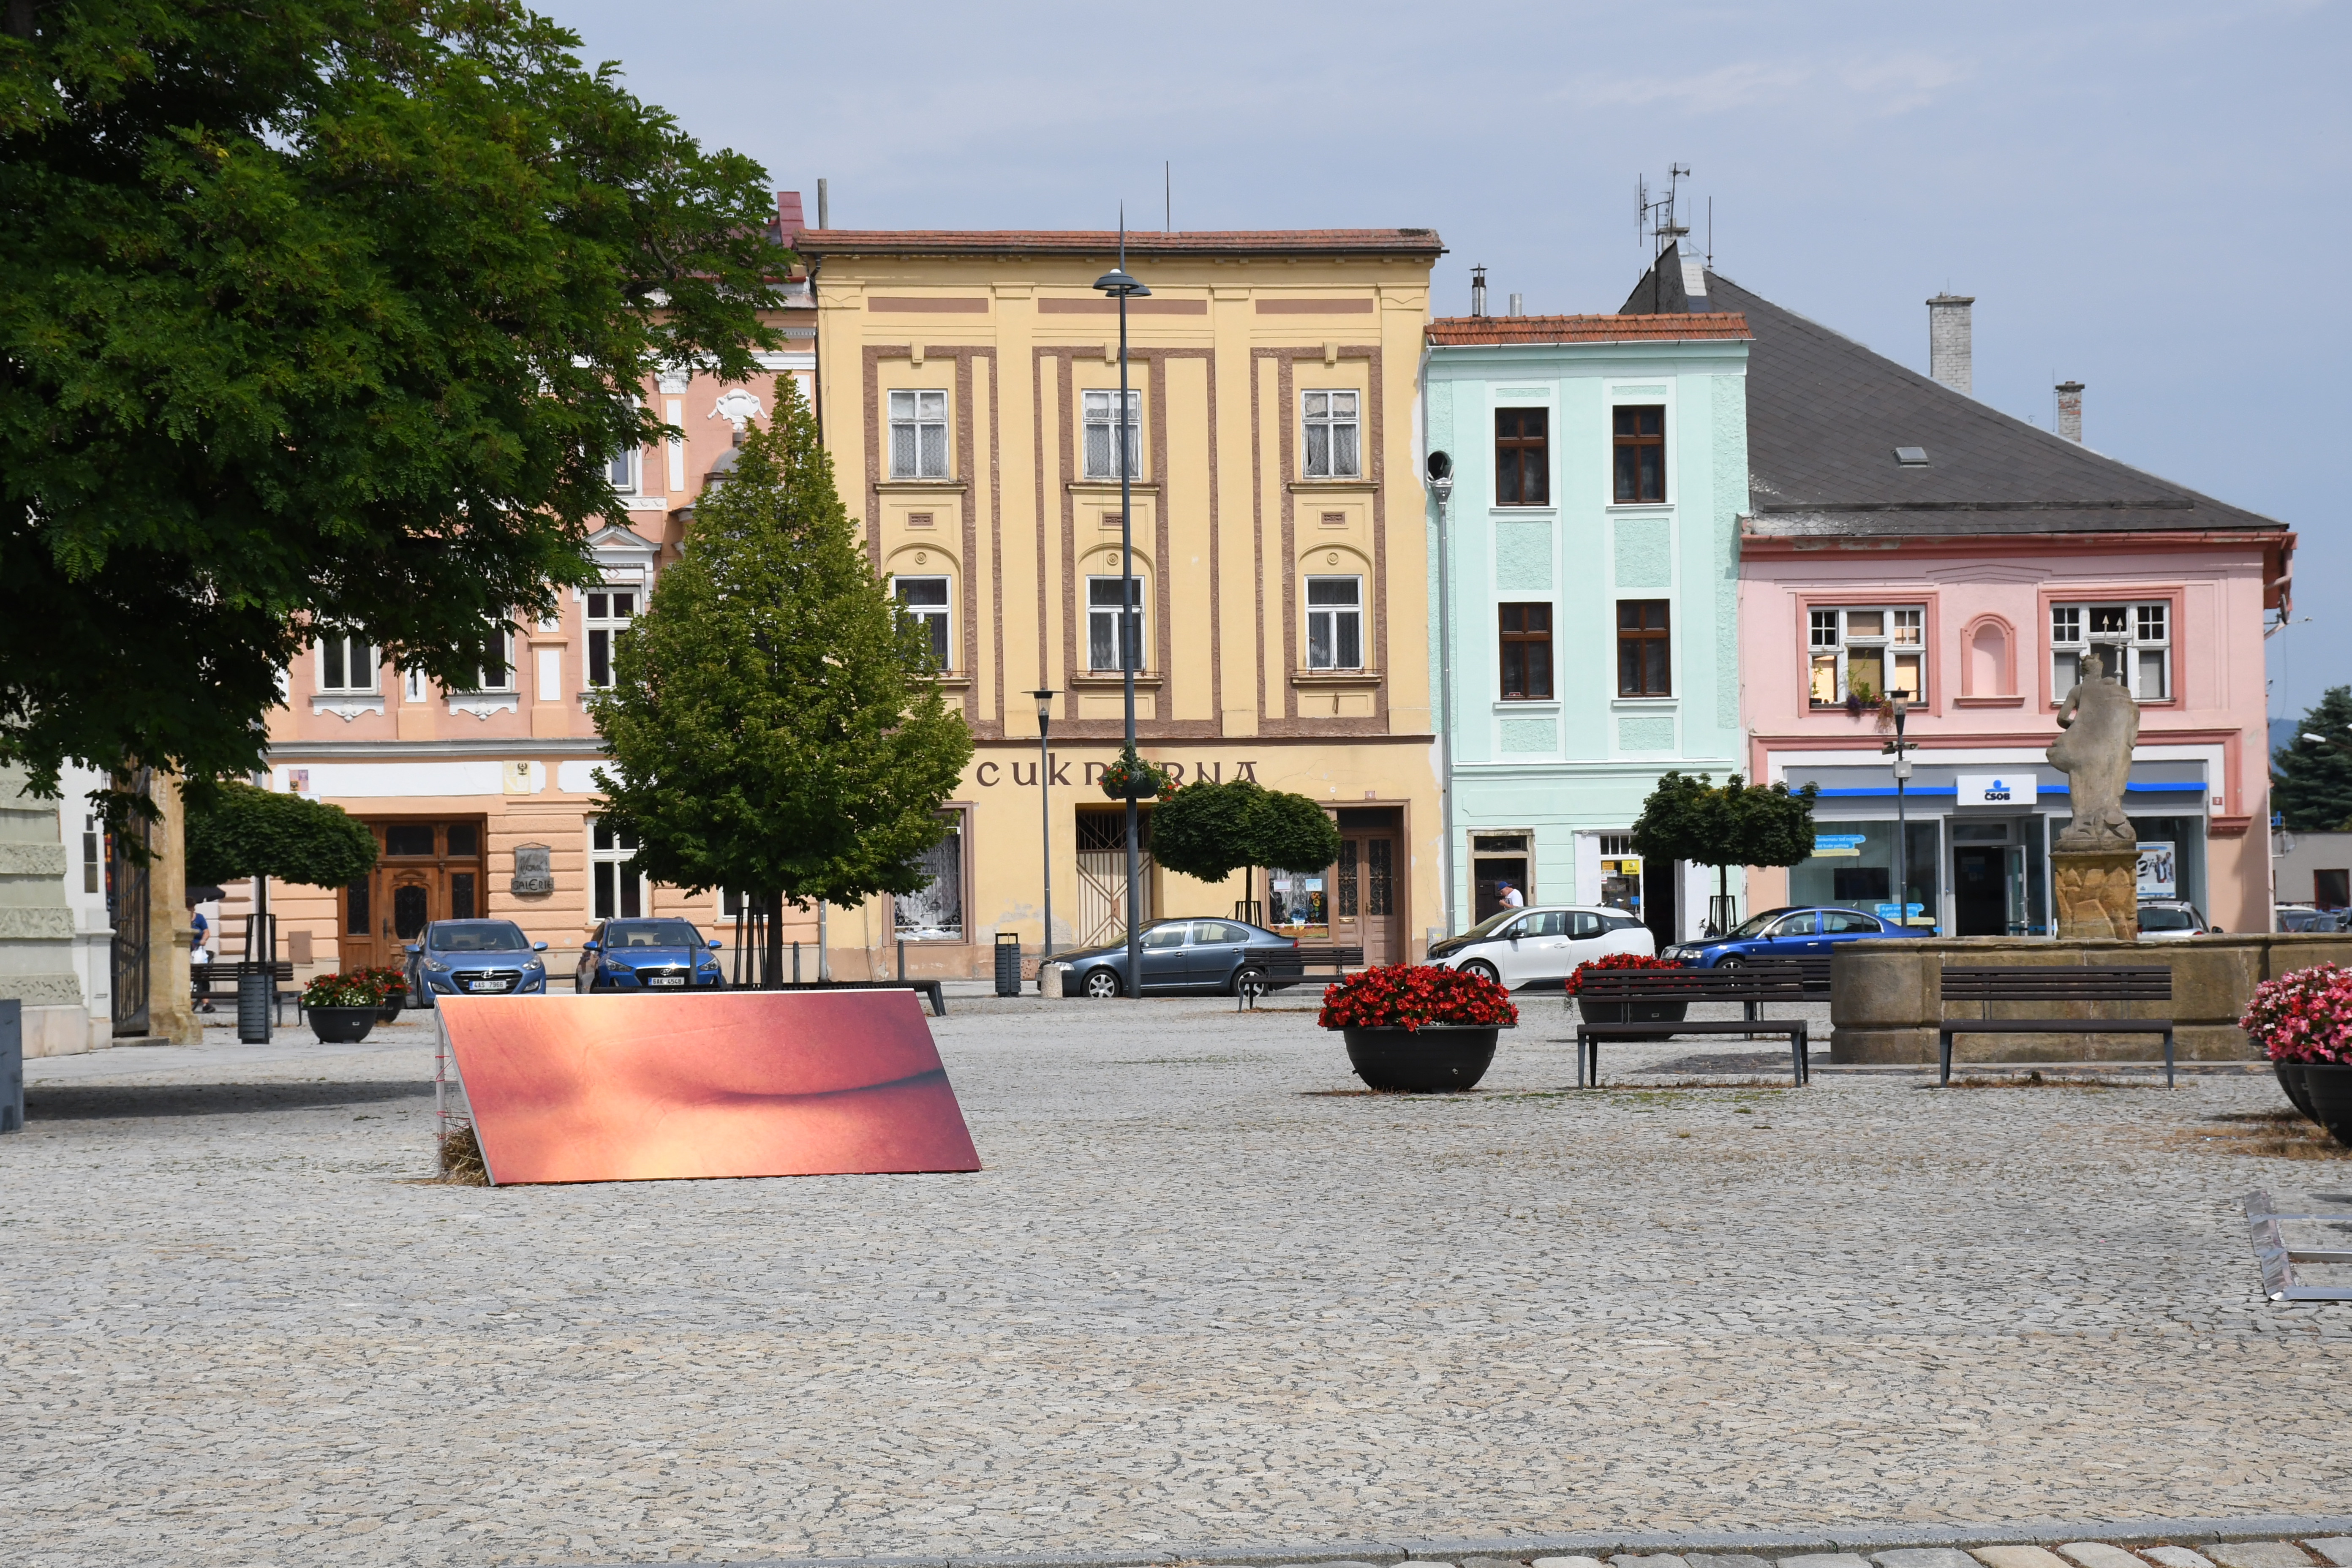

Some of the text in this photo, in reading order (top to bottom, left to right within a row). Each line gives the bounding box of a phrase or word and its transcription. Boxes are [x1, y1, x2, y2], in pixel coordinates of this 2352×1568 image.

[976, 753, 1258, 788] CUKRRNA
[1984, 792, 2010, 800] ČSOB
[512, 879, 553, 890] GALERIE
